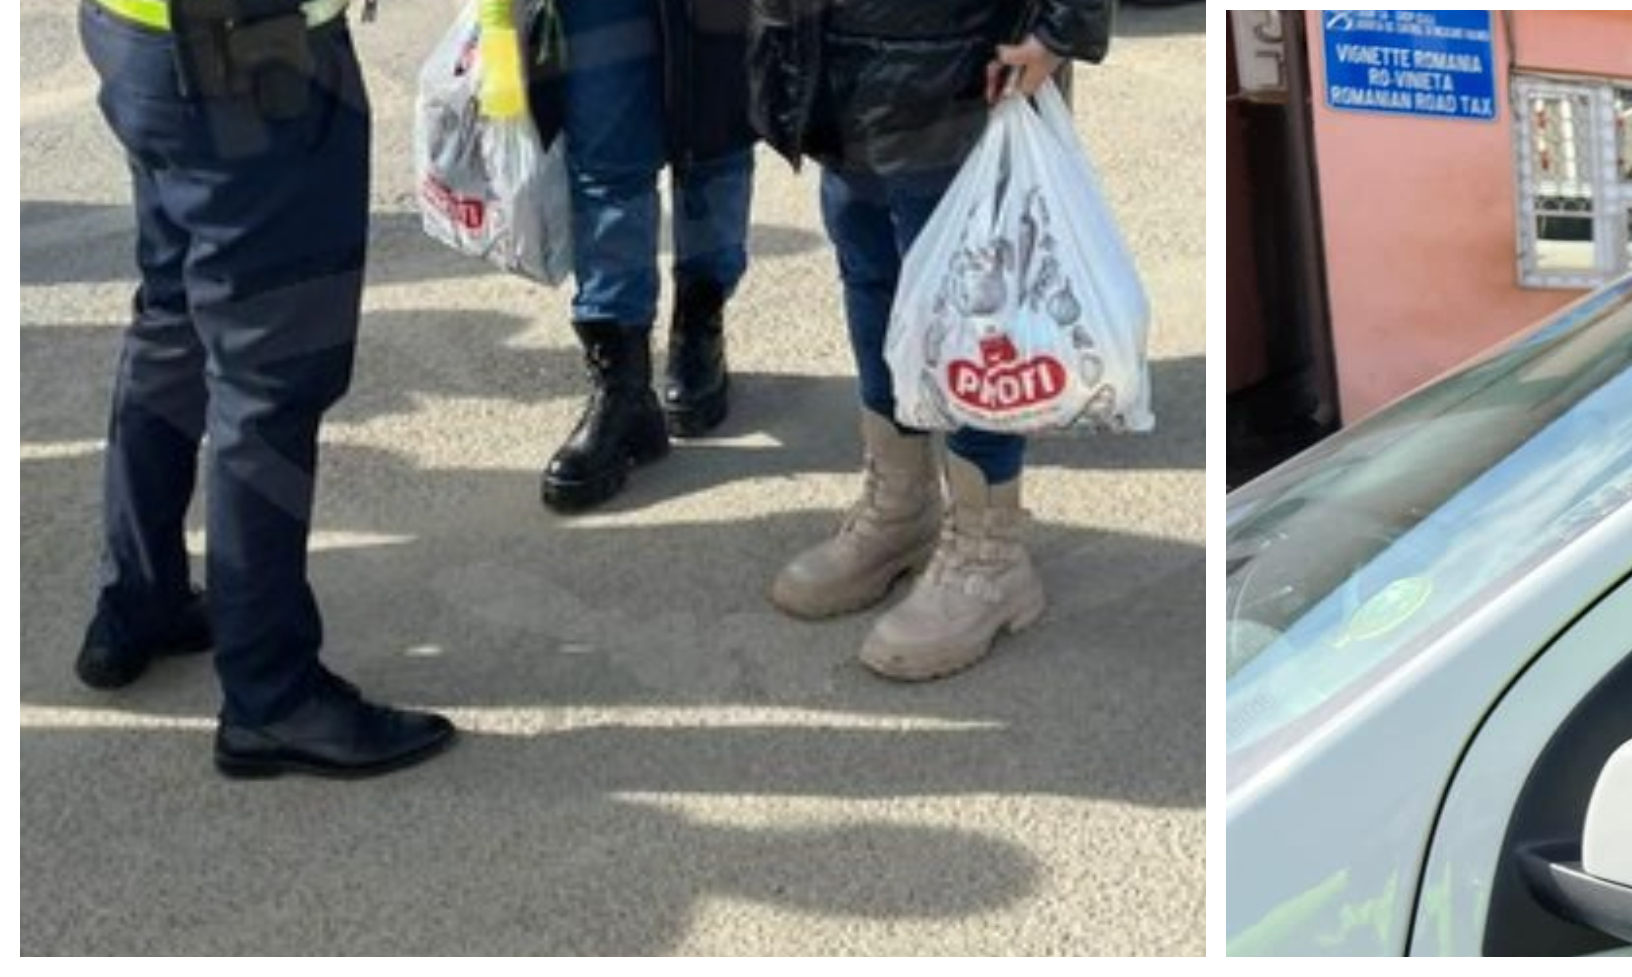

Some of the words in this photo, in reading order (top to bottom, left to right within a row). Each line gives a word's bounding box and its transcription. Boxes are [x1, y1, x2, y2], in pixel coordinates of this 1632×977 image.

[1335, 43, 1411, 68] VIGNETTE
[1413, 50, 1483, 74] ROMANIA
[1330, 86, 1412, 110] ROMANIAN
[1414, 91, 1457, 113] ROAD
[1459, 95, 1493, 116] TAX
